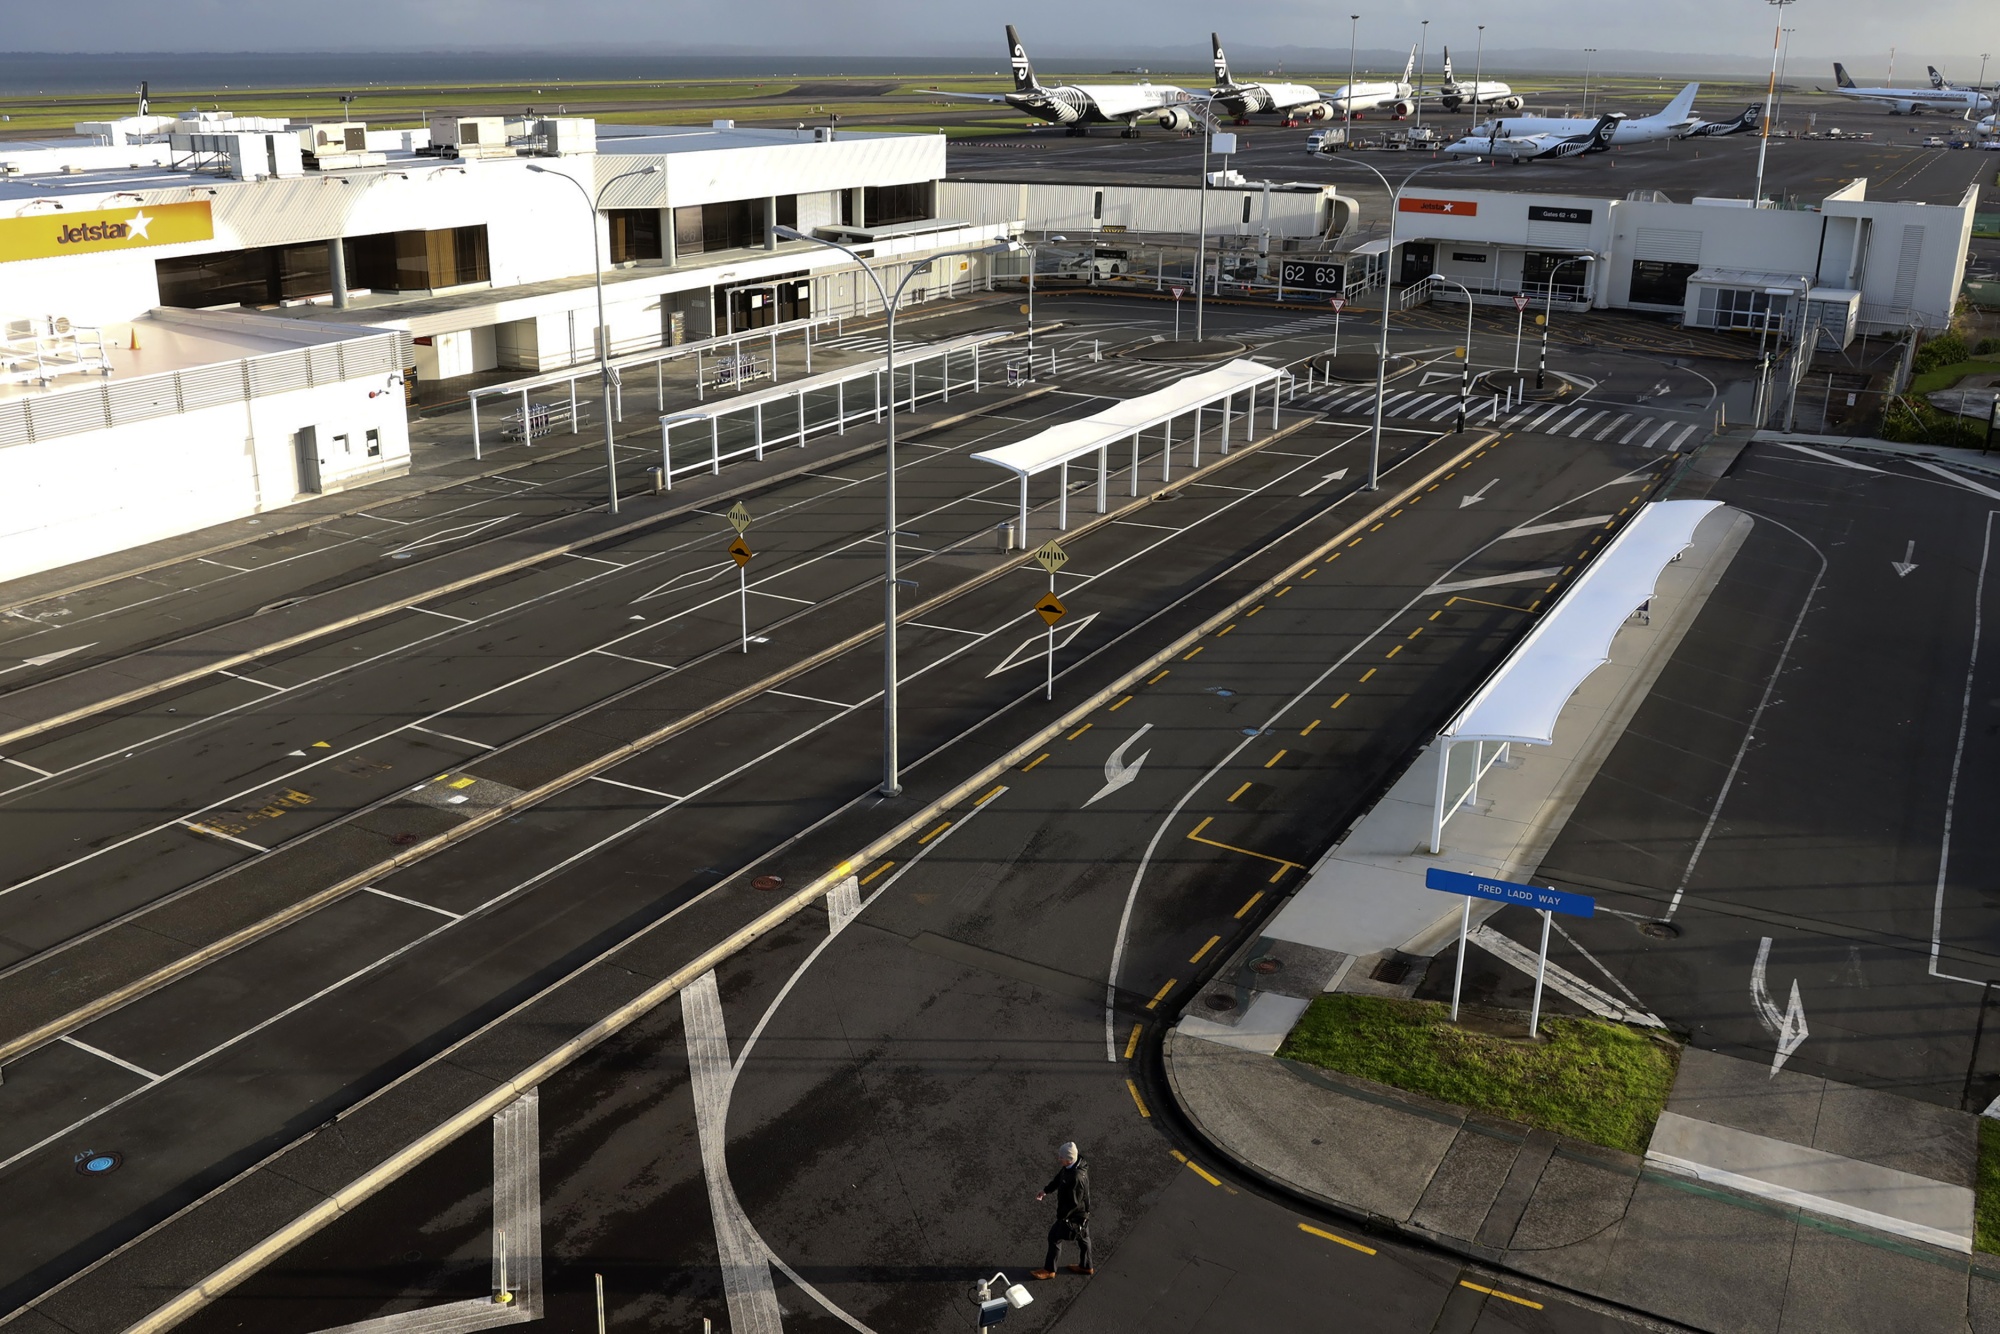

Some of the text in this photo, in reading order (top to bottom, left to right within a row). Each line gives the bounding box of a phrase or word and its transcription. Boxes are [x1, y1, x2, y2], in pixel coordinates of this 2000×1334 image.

[1543, 210, 1558, 218] Gates
[57, 221, 128, 244] Jetstar
[1284, 265, 1336, 284] 62 63
[1477, 883, 1561, 906] FRED LADD WAY
